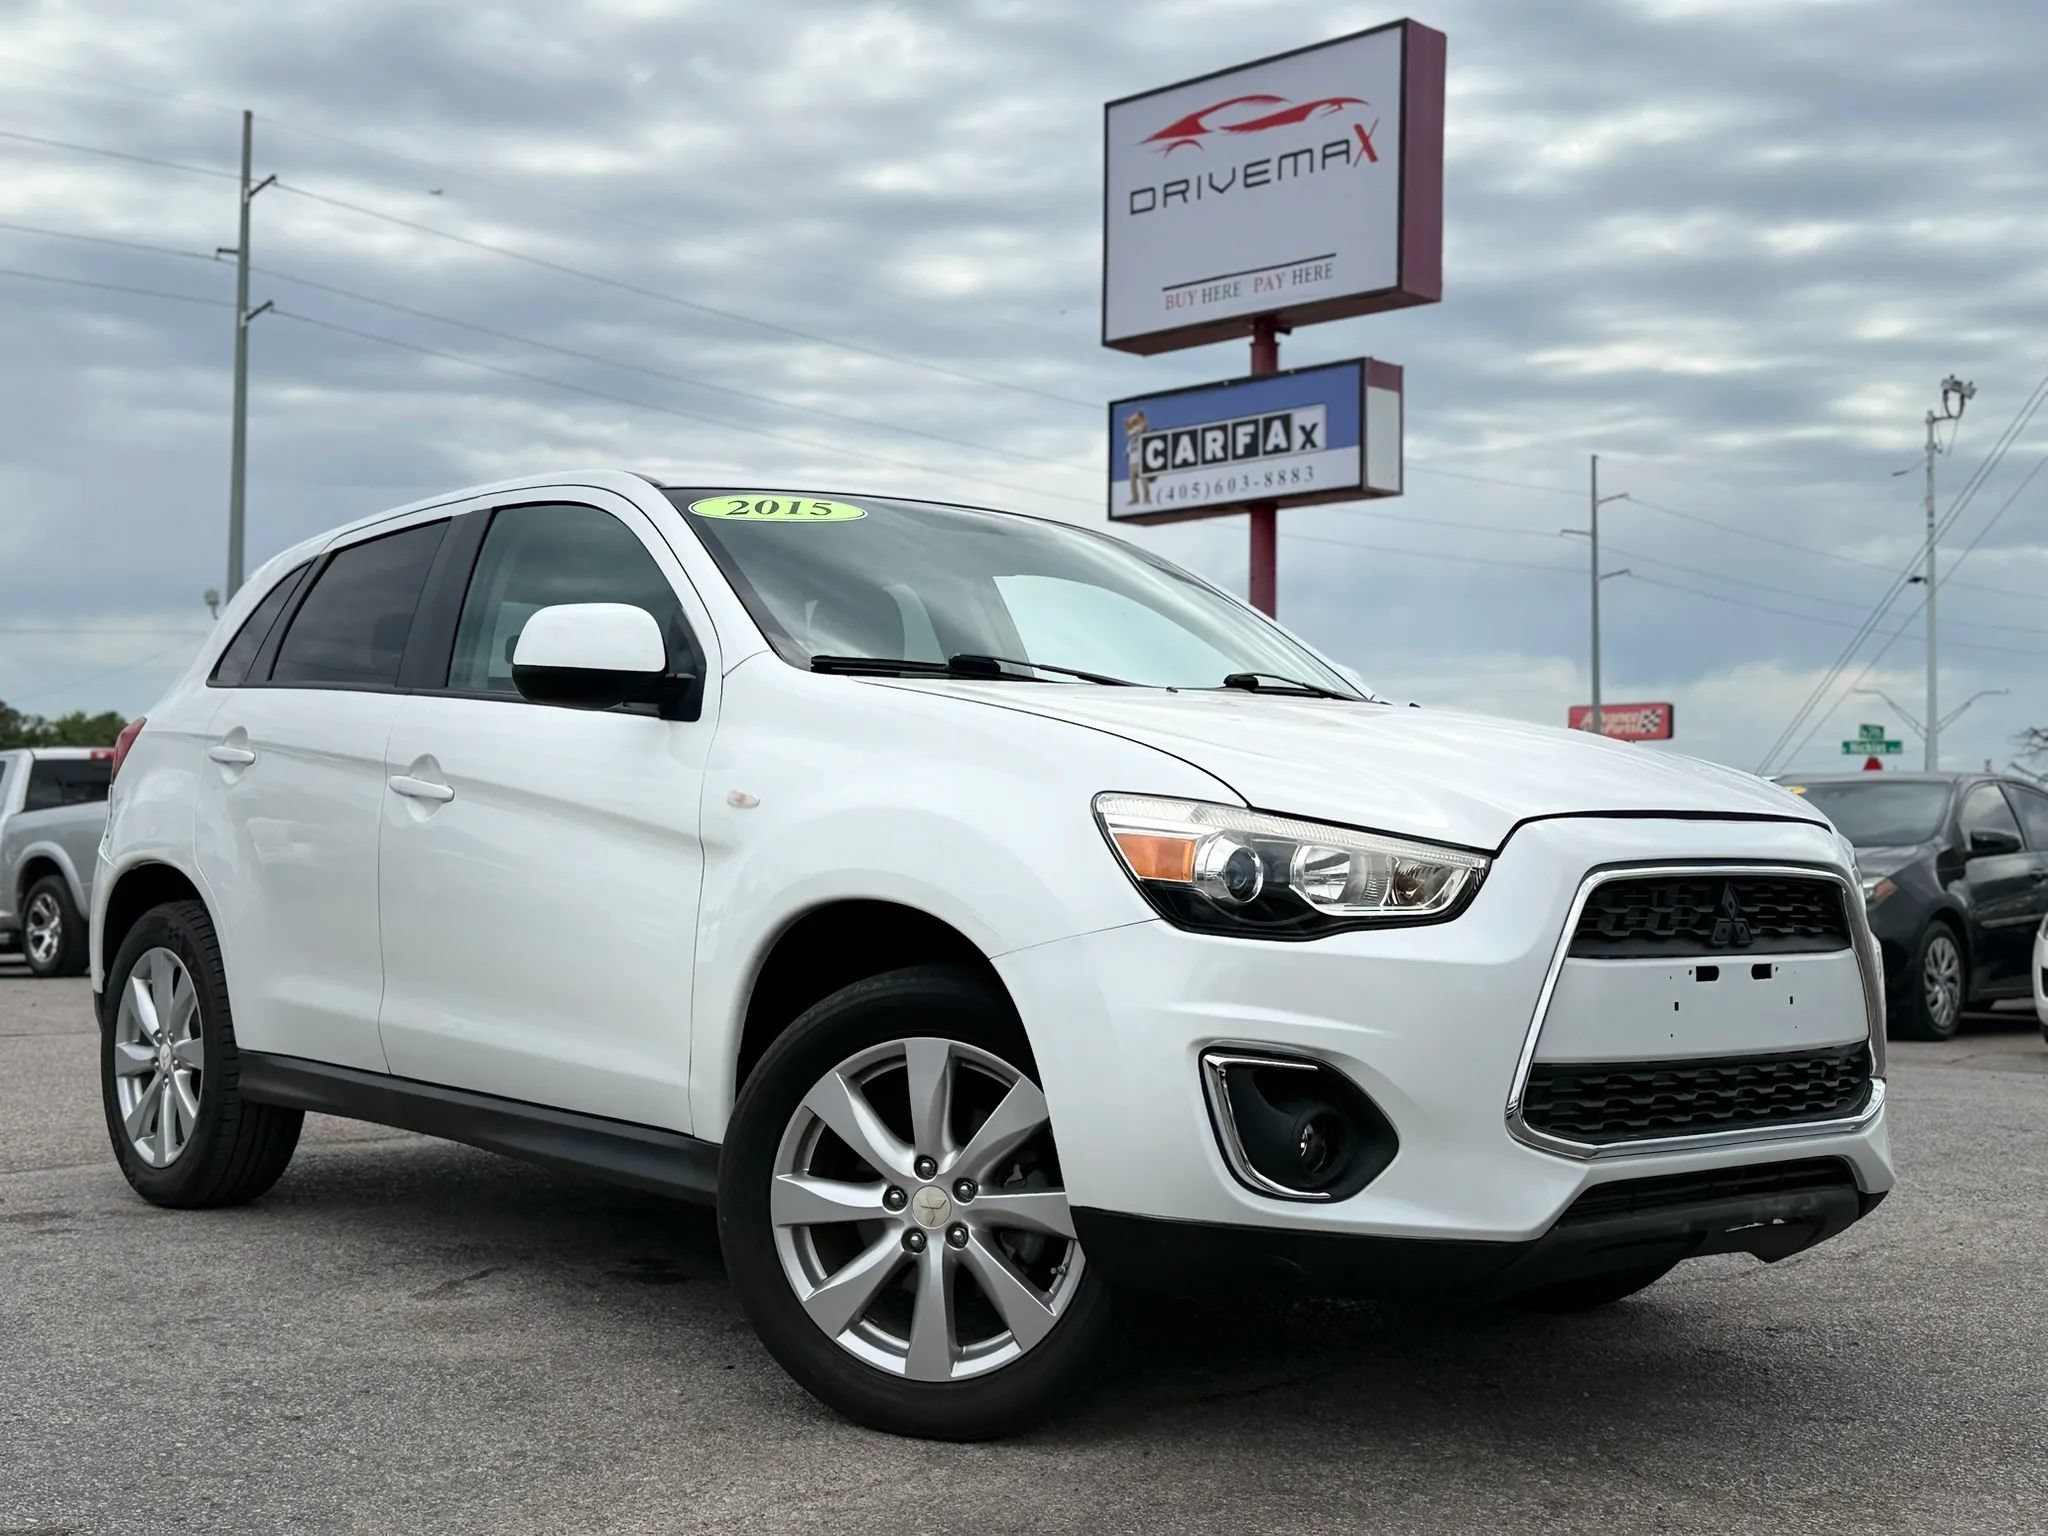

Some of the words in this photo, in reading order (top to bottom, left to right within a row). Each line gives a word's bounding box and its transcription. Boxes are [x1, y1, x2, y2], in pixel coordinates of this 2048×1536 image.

[1130, 118, 1379, 215] DRIVEMAX
[1165, 288, 1198, 311] BUY
[1201, 281, 1242, 305] HERE
[1253, 271, 1286, 294] PAY
[1292, 262, 1333, 286] HERE
[1145, 418, 1320, 470] CARFAX
[725, 499, 832, 516] 2015
[1156, 465, 1316, 506] (405)603-8883
